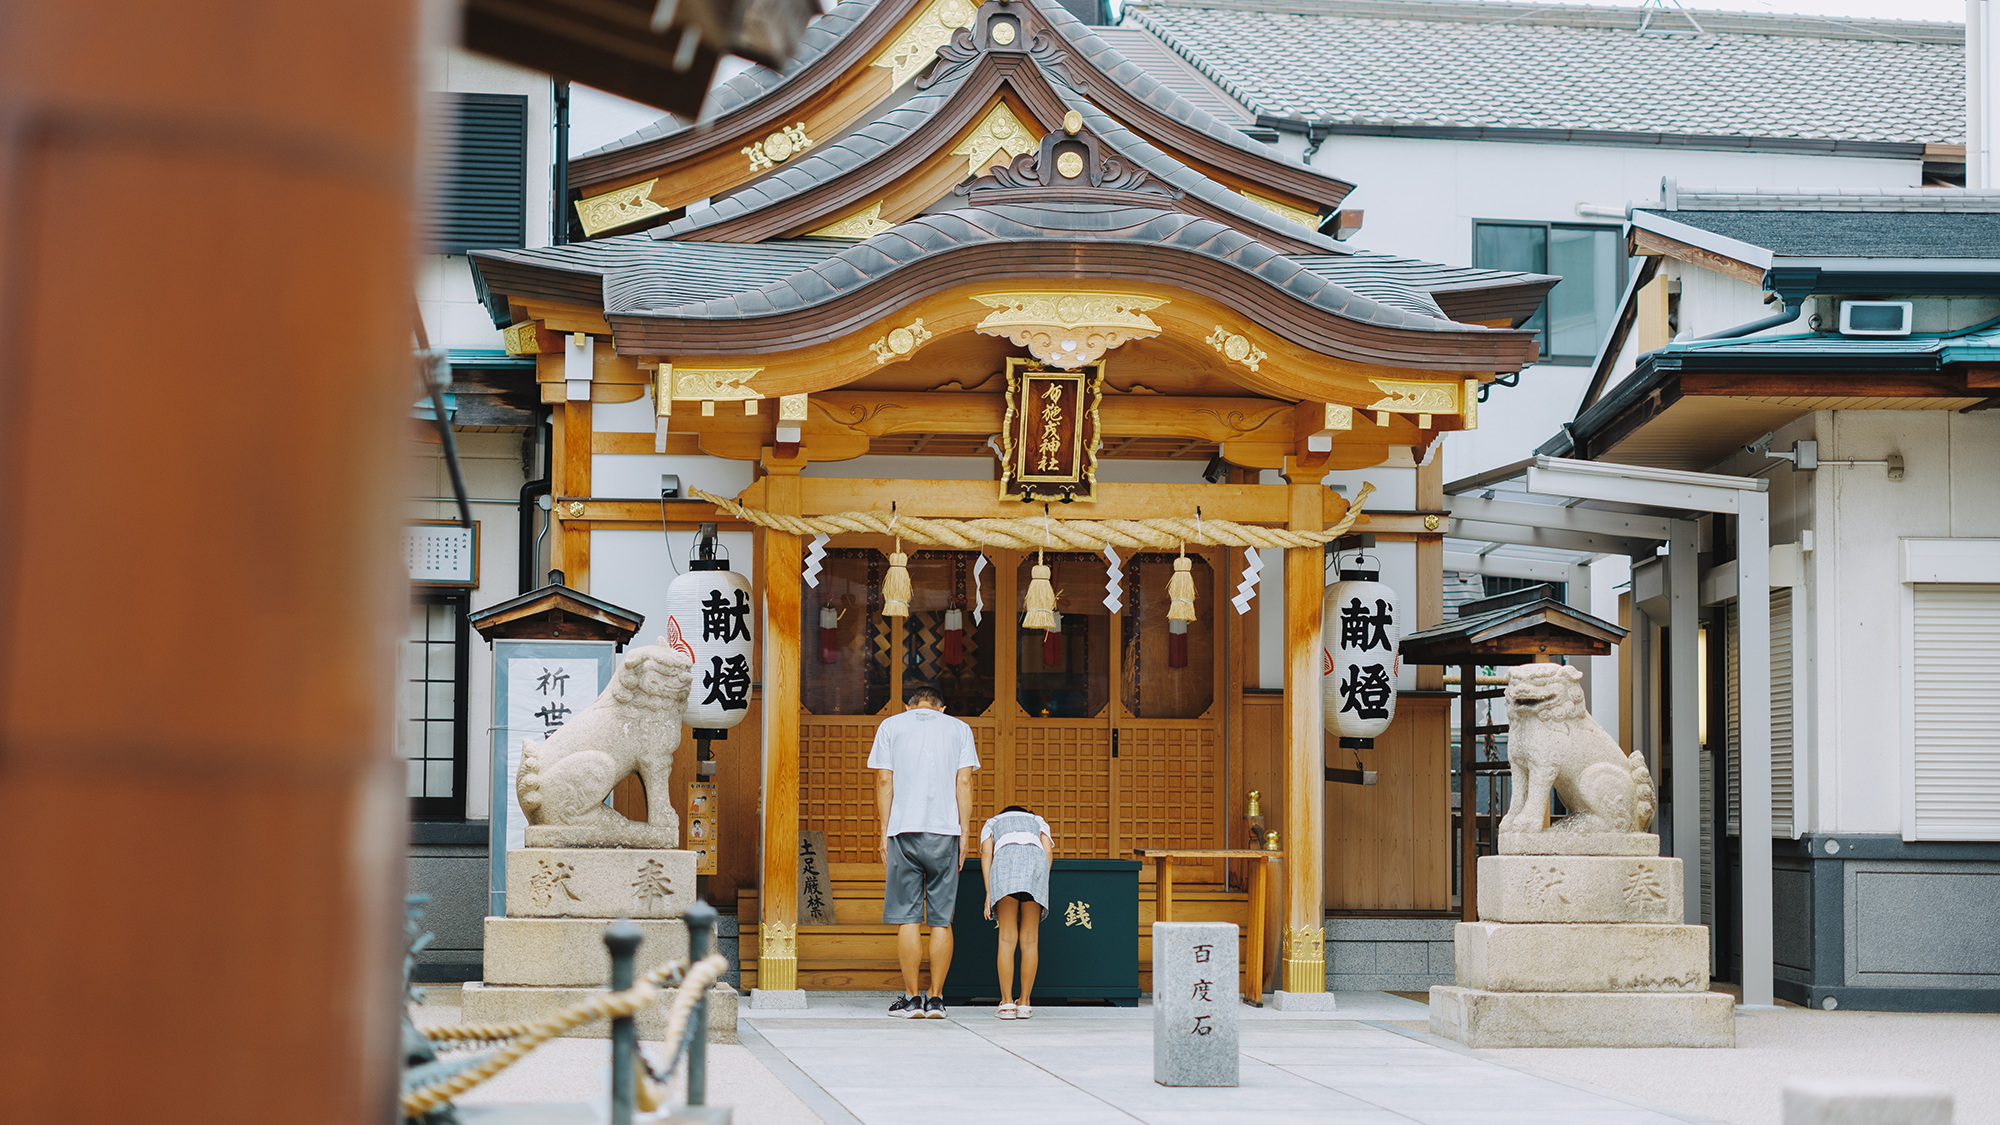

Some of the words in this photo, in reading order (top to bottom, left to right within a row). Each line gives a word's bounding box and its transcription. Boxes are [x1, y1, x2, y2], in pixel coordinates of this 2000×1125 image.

[701, 588, 751, 711] 献燈
[1340, 597, 1393, 719] 献燈
[534, 666, 572, 740] 祈世
[799, 839, 825, 918] 土足厳禁
[1191, 944, 1214, 1036] 百度石
